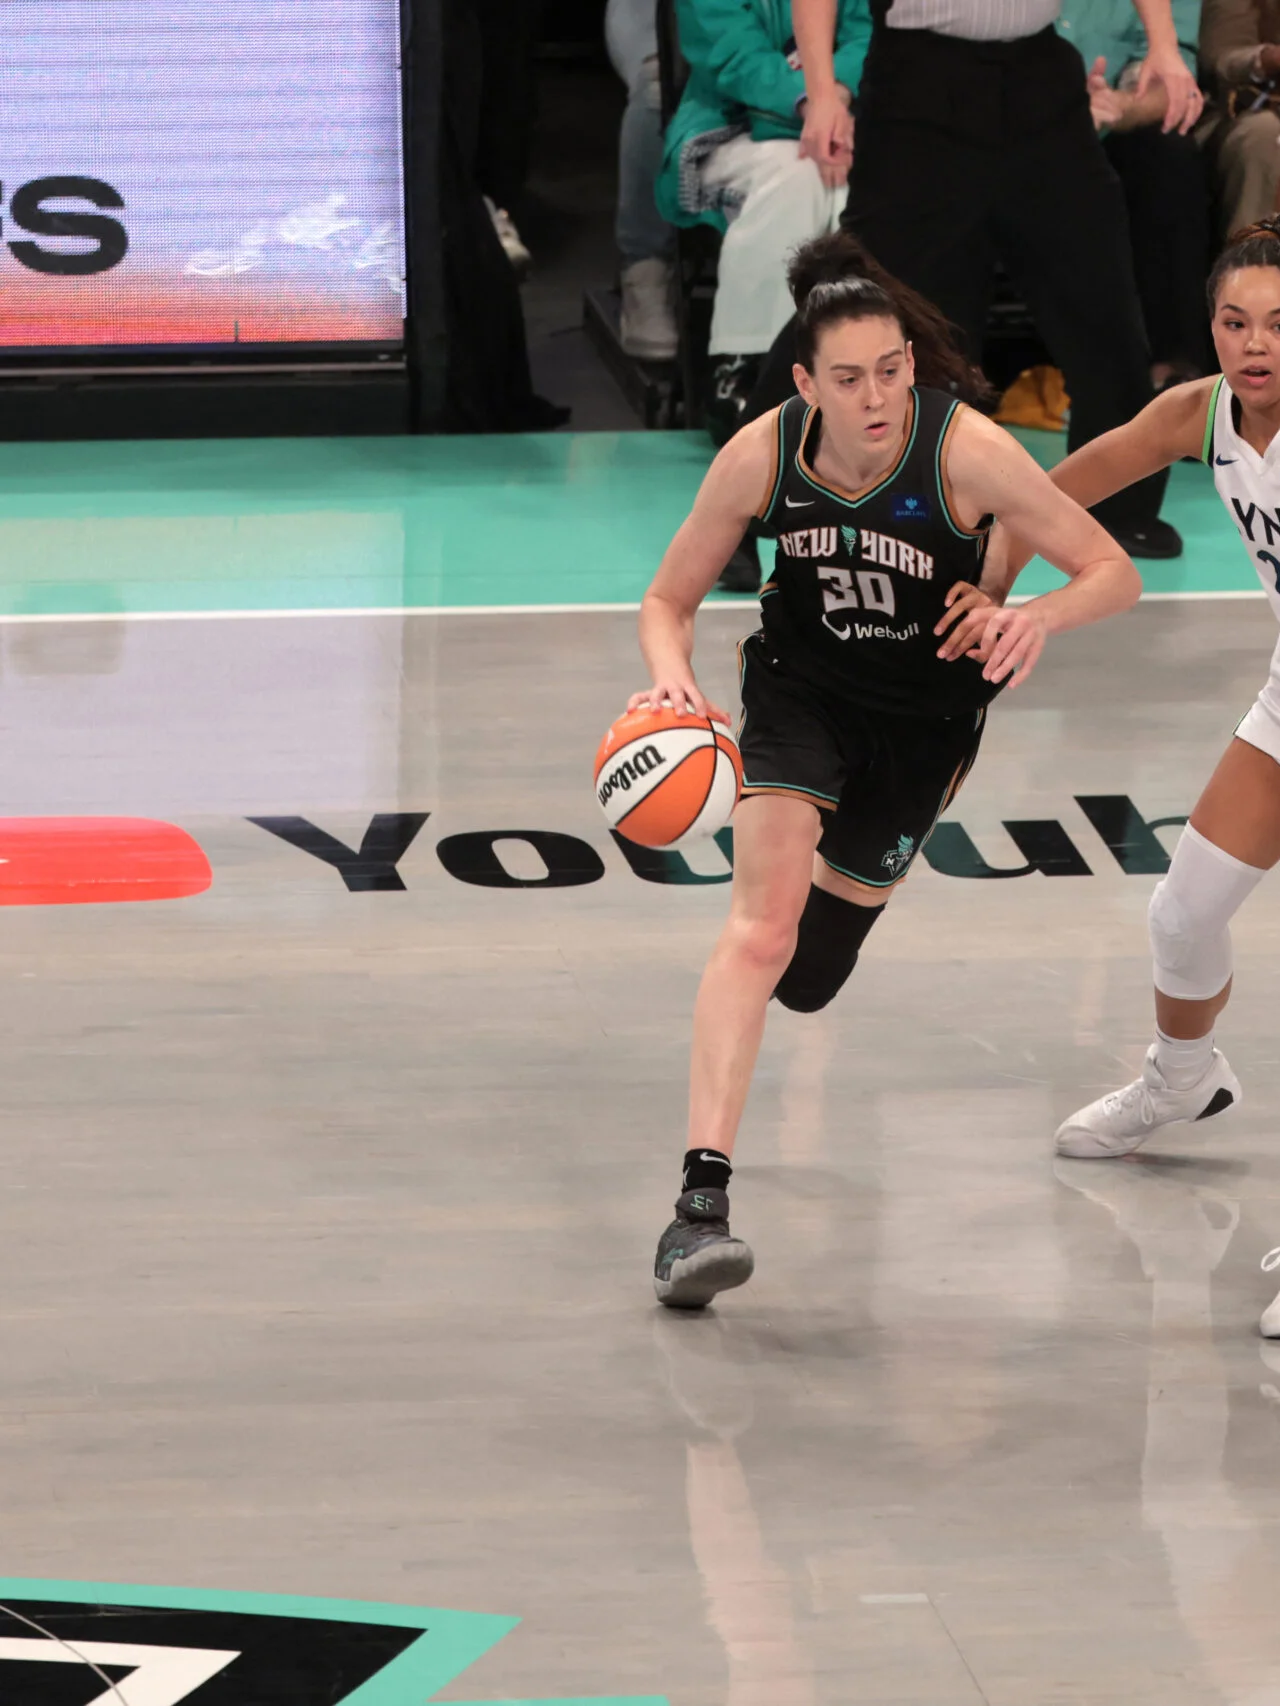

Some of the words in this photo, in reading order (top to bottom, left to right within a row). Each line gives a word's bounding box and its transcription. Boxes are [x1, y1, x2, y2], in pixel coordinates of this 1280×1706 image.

[0, 175, 129, 275] S
[780, 527, 838, 558] NEW
[861, 529, 934, 580] YORK
[817, 567, 896, 618] 30
[854, 622, 920, 641] Webull
[598, 744, 666, 808] Wilson
